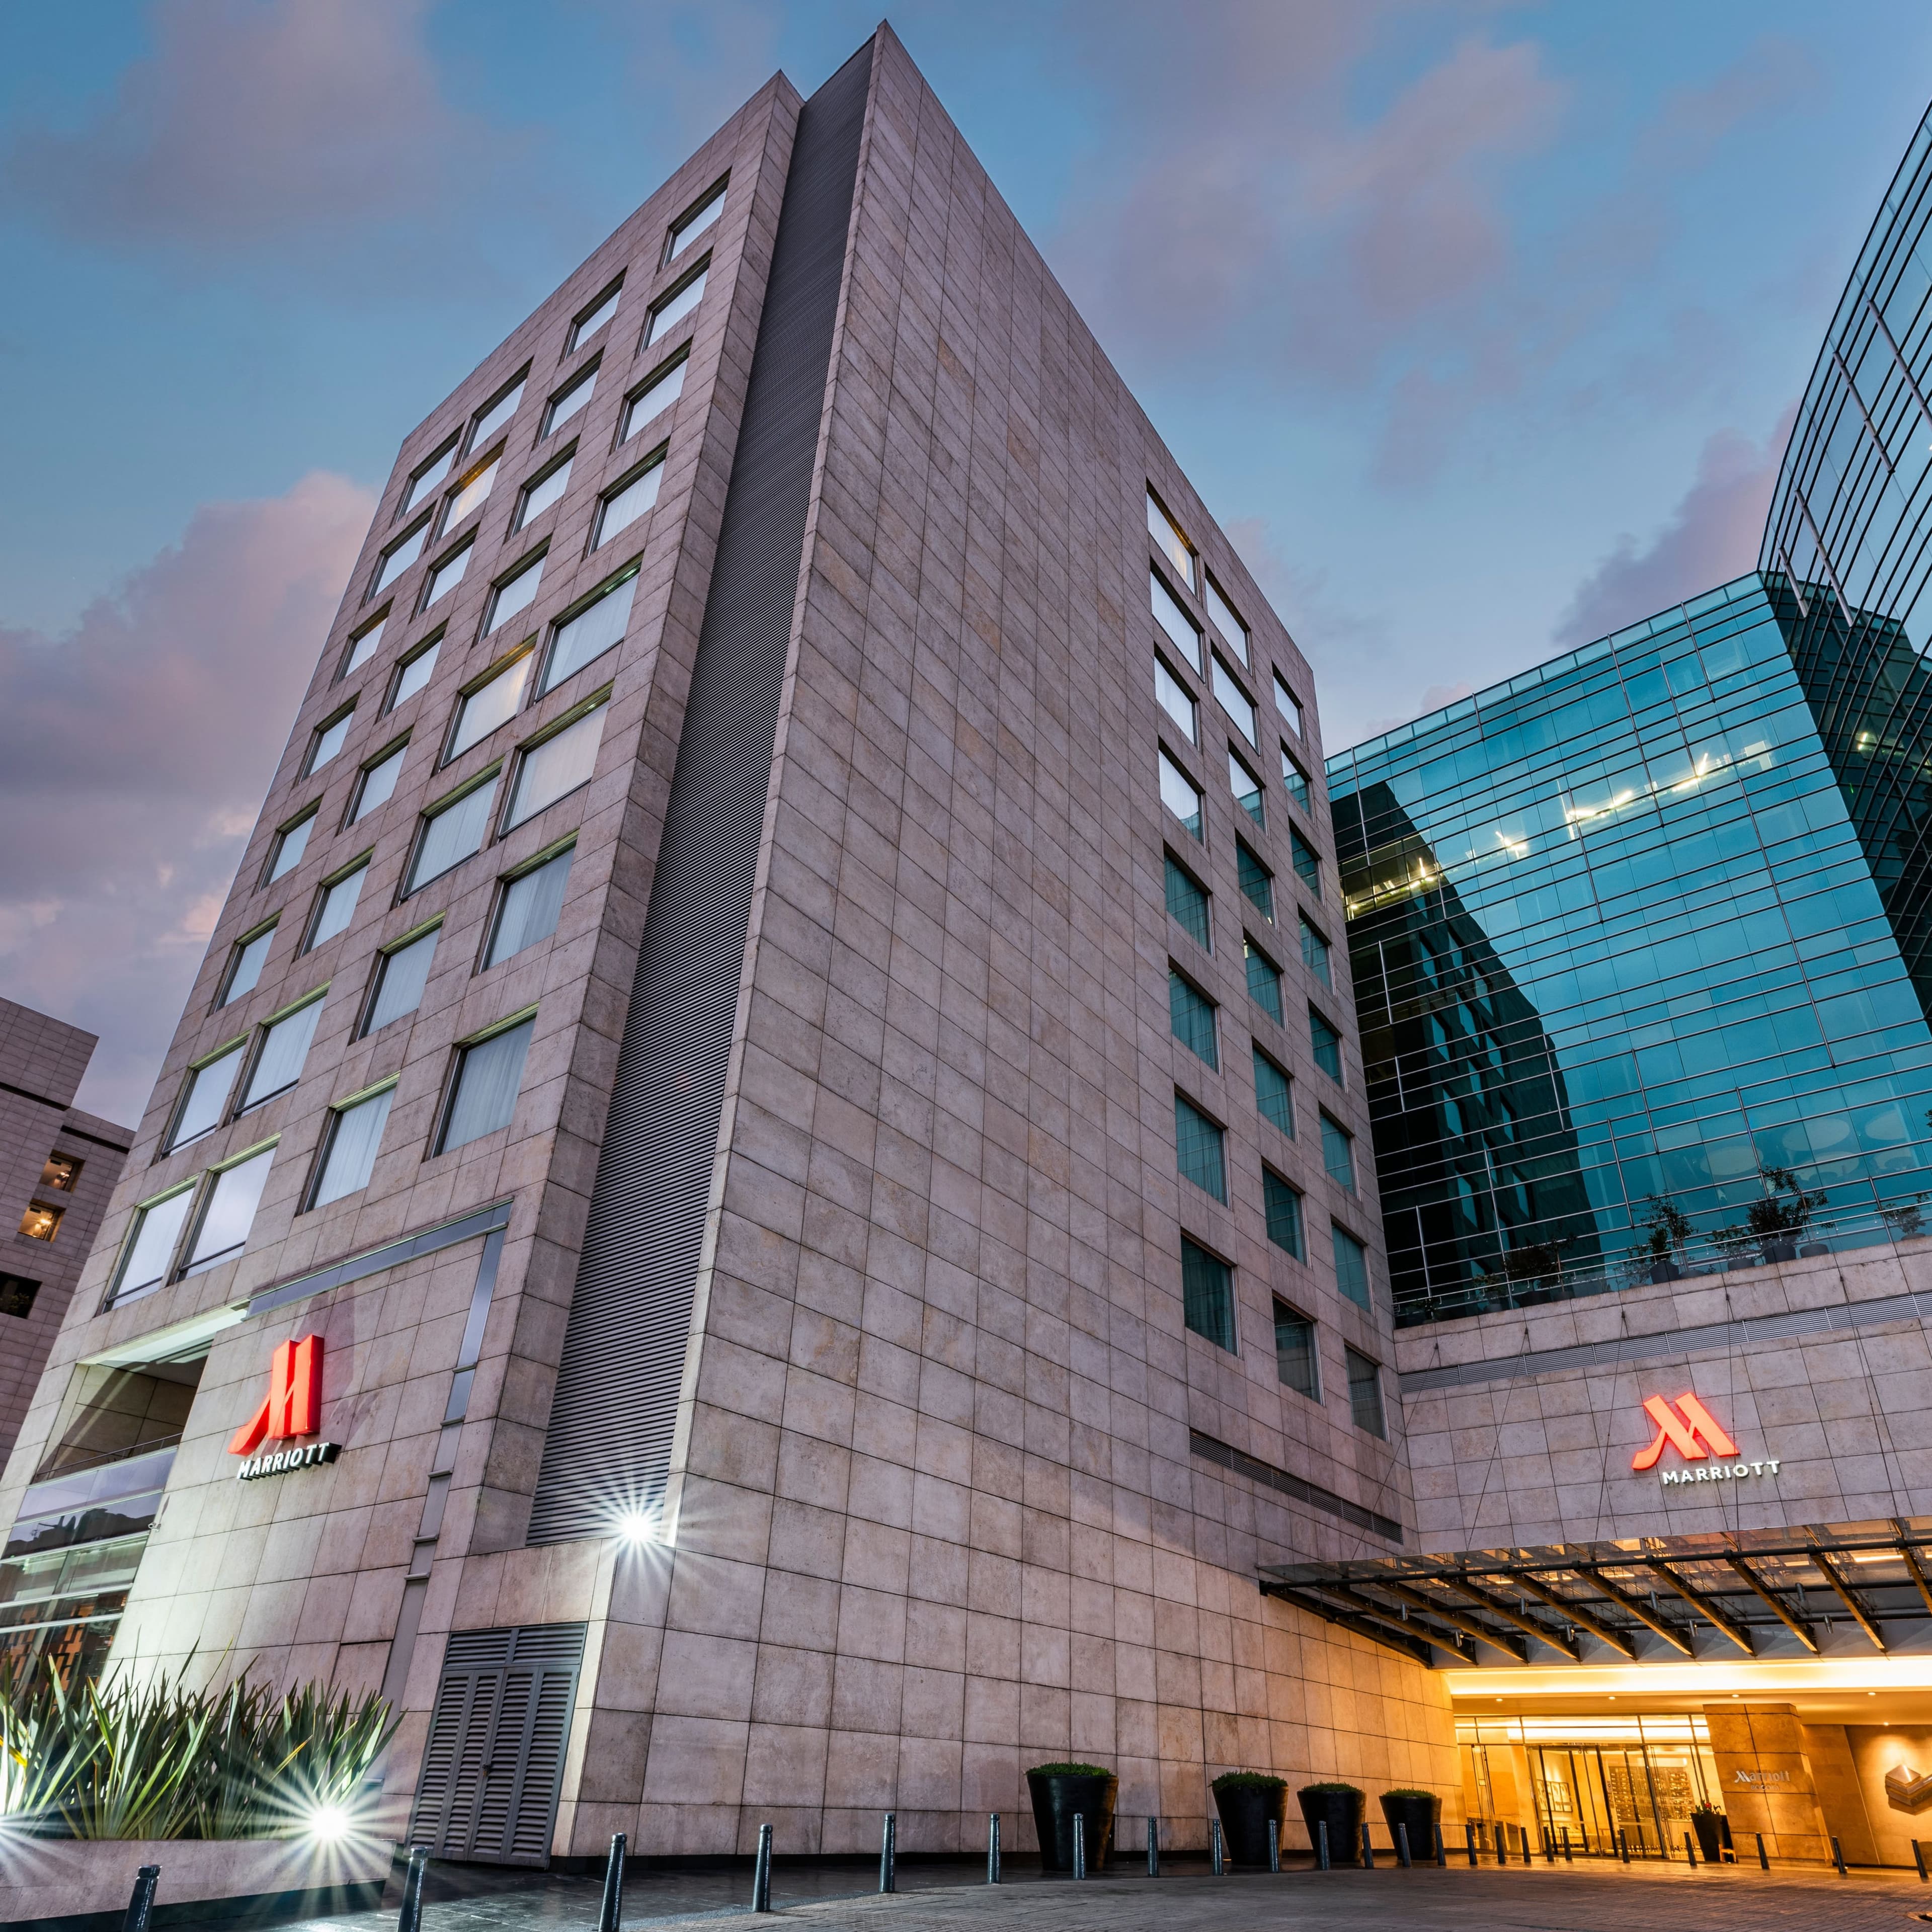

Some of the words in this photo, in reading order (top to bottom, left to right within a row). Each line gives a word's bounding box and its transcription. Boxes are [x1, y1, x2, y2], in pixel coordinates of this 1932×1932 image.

[236, 1442, 335, 1481] MARRIOTT
[1662, 1460, 1780, 1485] MARRIOTT
[1734, 1770, 1791, 1783] Marriott
